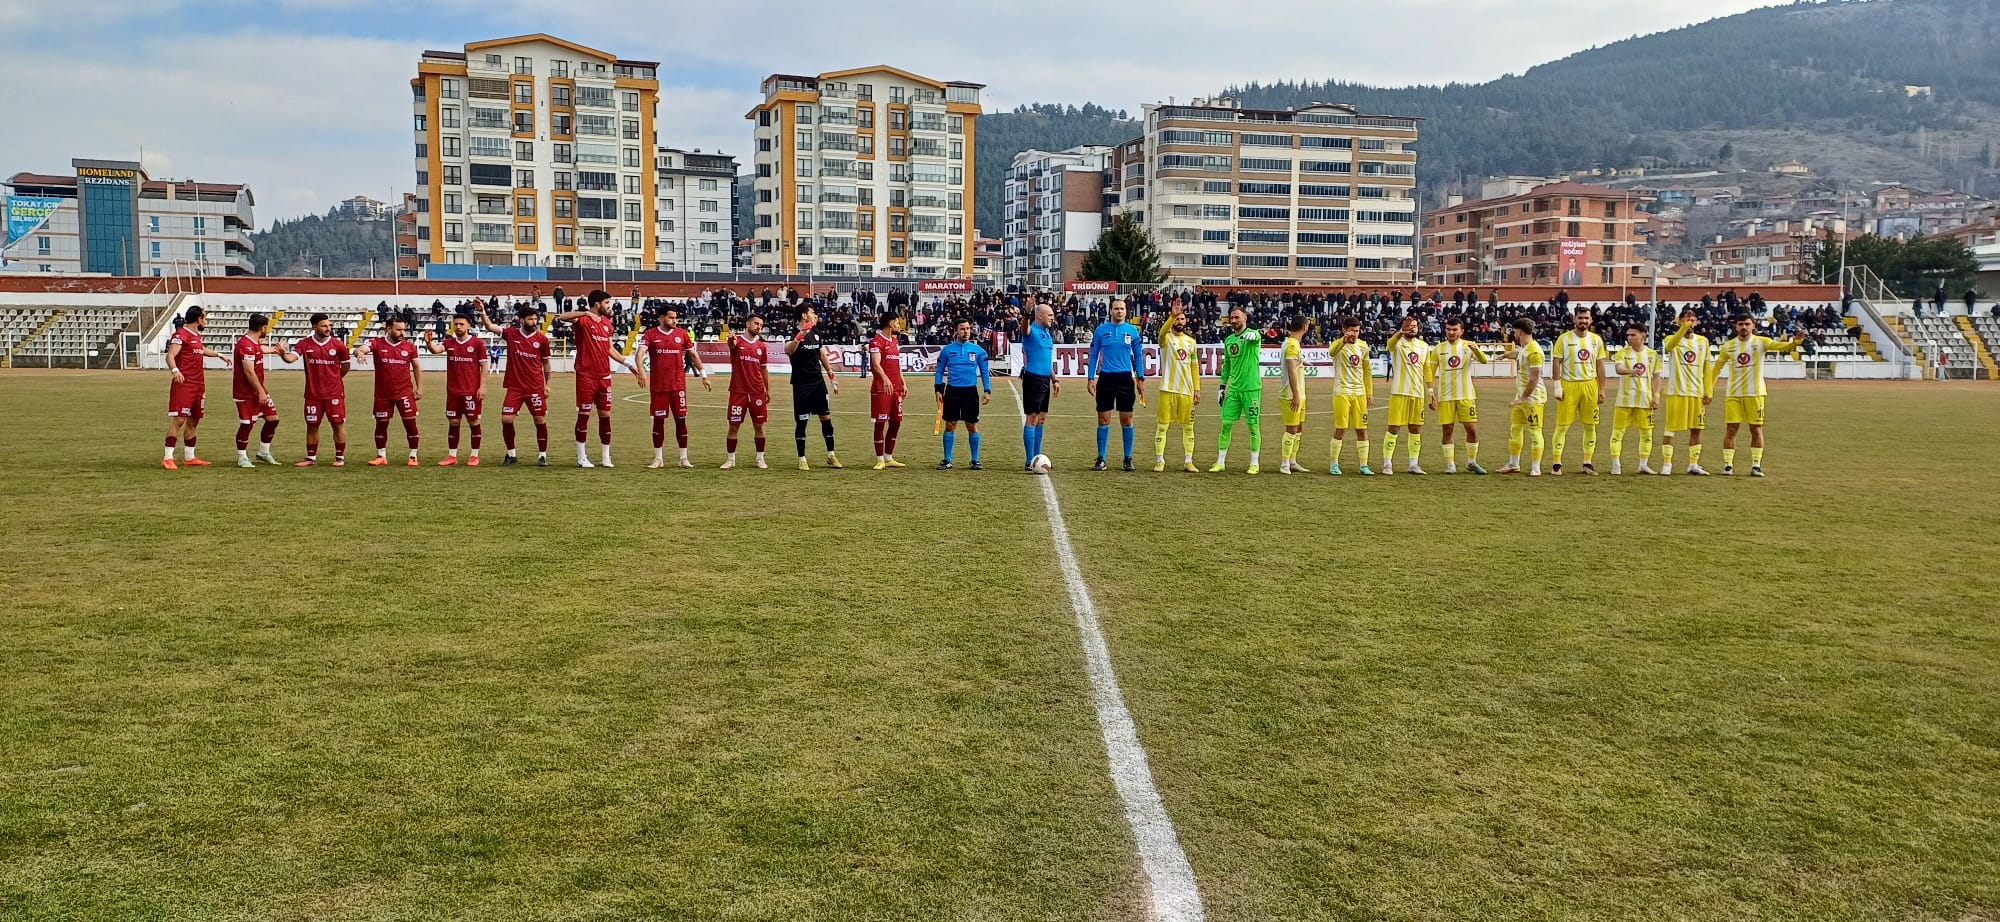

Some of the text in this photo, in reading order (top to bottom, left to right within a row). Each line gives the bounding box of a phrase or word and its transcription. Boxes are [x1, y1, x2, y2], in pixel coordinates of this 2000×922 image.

[79, 168, 134, 178] HOMELAND
[85, 177, 130, 186] REZİDANS
[11, 200, 41, 208] TOKAT
[925, 282, 966, 290] MARATON
[404, 398, 411, 409] 5
[465, 401, 475, 411] 30
[680, 398, 686, 407] 9
[307, 405, 317, 414] 19
[731, 405, 742, 415] 58
[1528, 414, 1538, 423] 41
